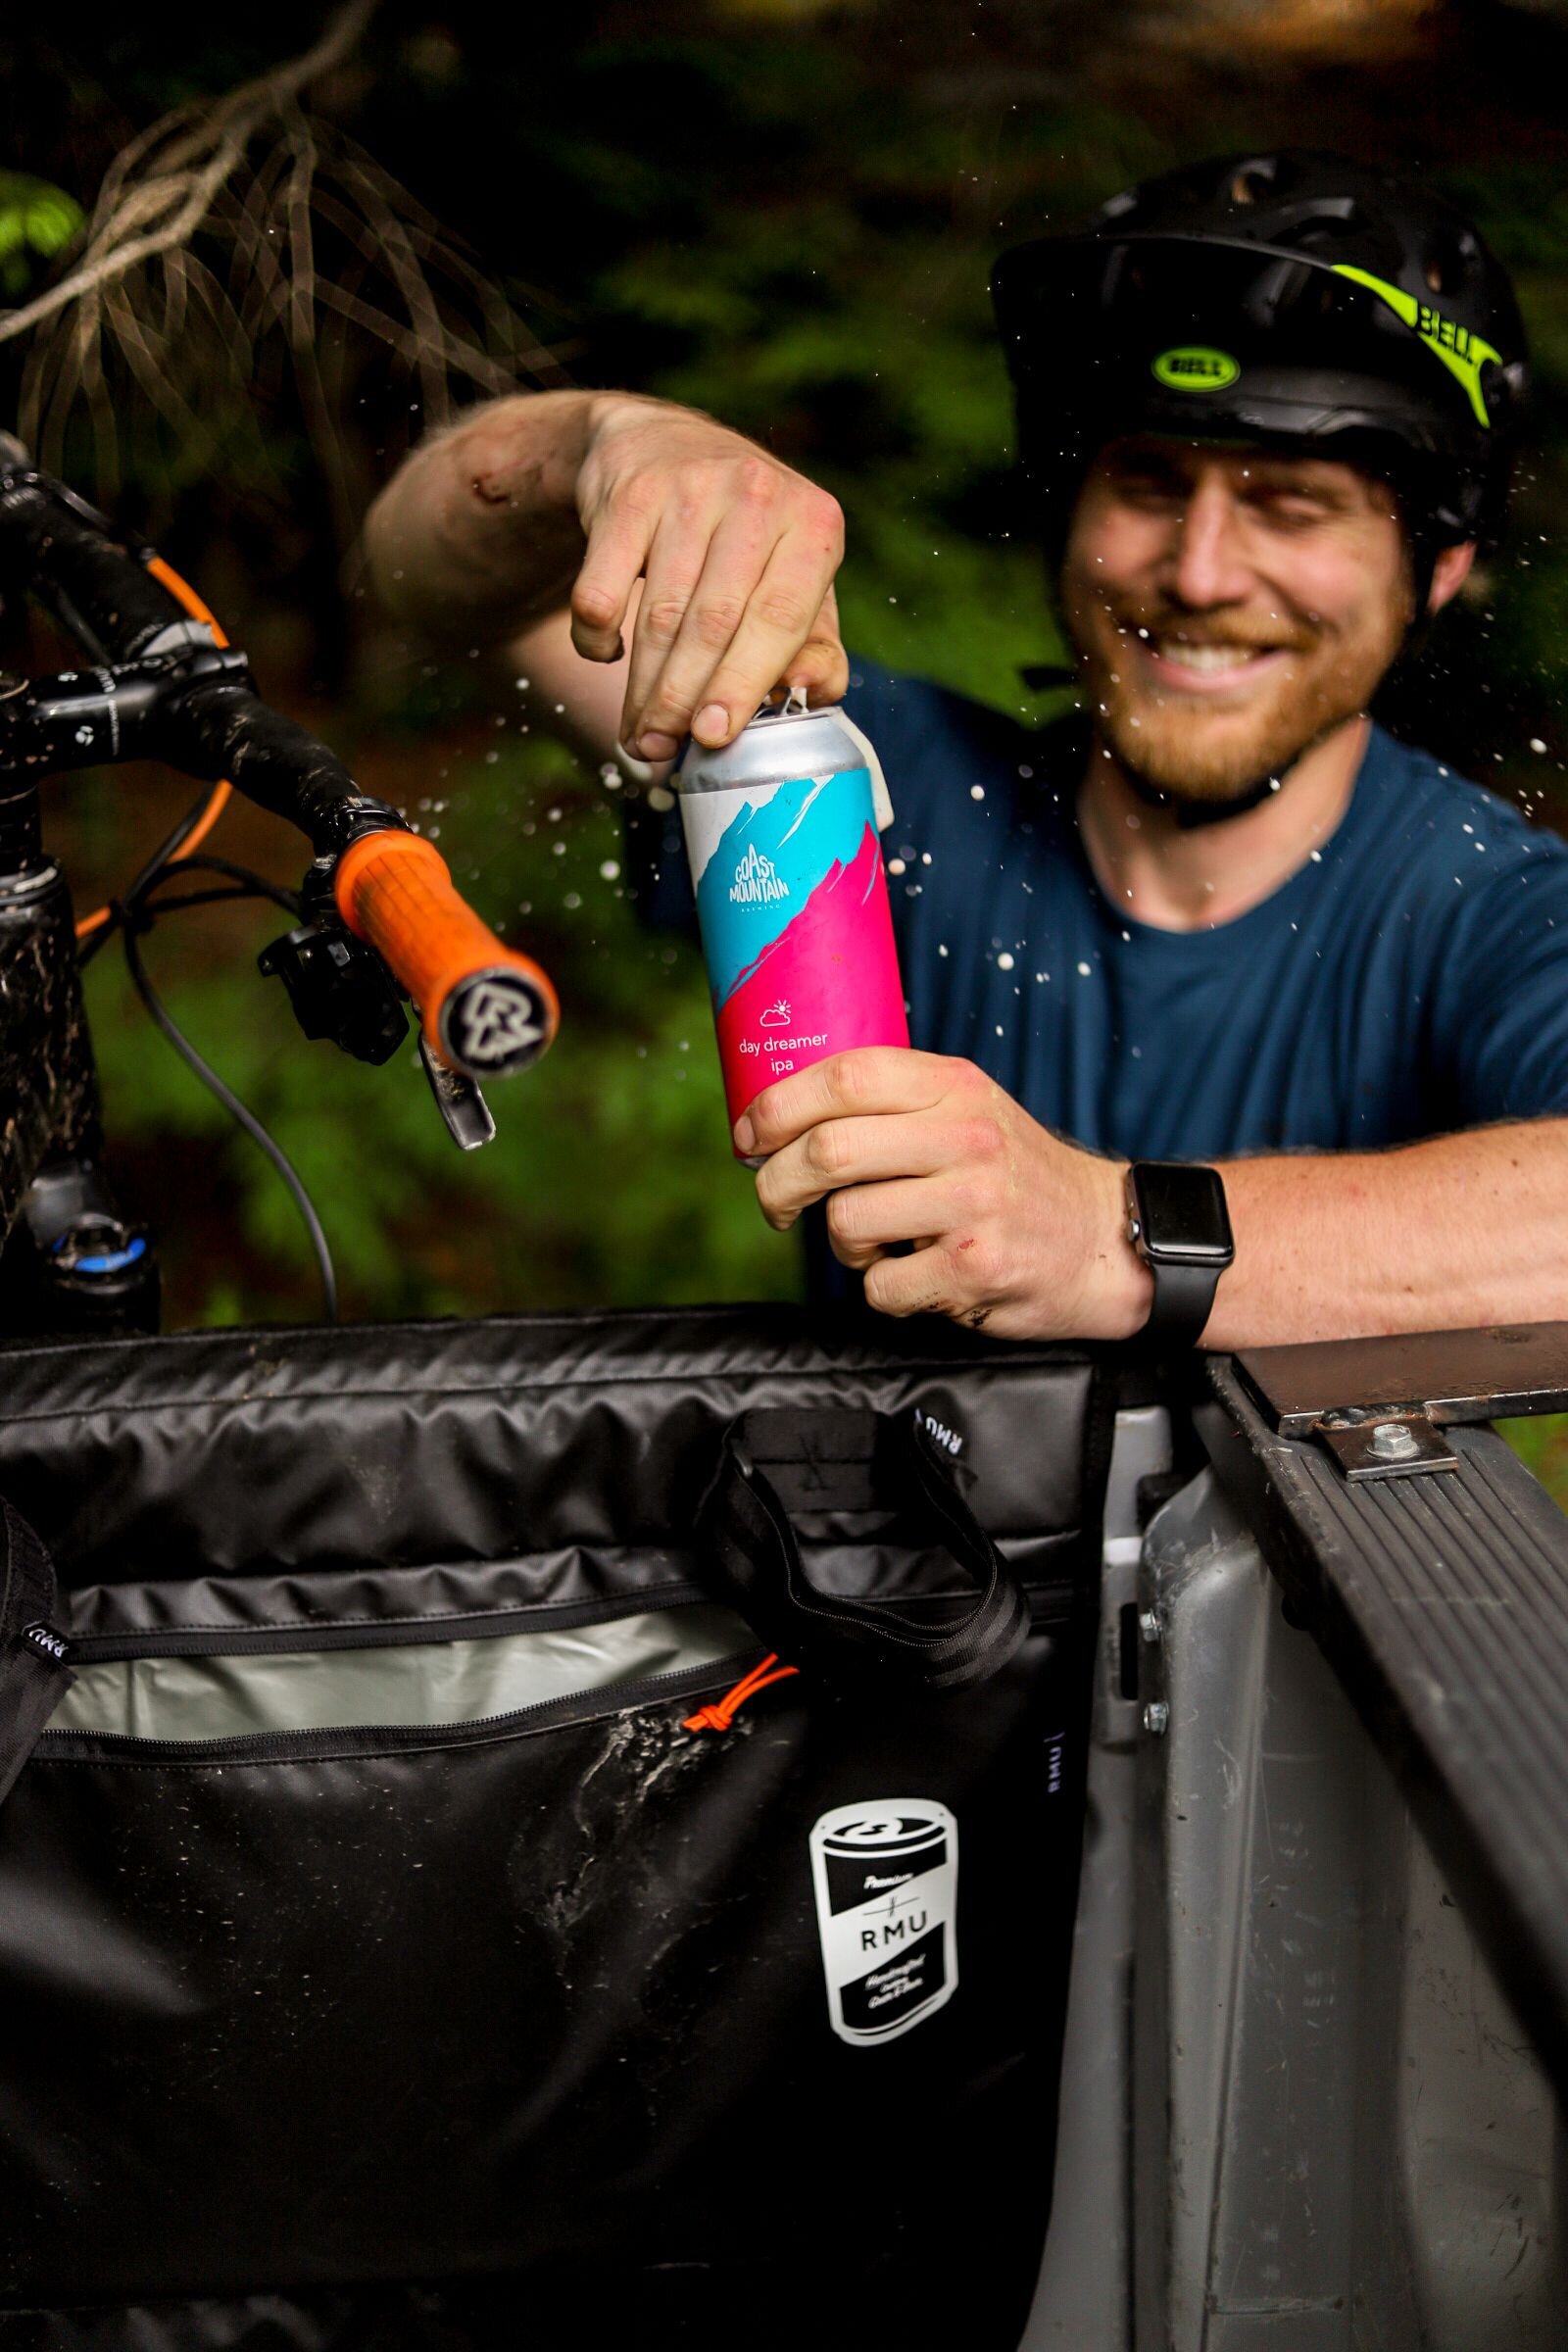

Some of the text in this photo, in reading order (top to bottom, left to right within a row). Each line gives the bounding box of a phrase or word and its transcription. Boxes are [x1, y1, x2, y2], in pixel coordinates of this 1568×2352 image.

[1417, 303, 1474, 366] BELL
[1169, 358, 1222, 377] BELL
[735, 843, 776, 883] COAST
[729, 877, 790, 903] MOUNTAIN
[739, 1034, 828, 1056] day dreamer
[770, 1058, 794, 1076] ipa
[925, 1416, 962, 1454] RMU
[28, 1629, 70, 1657] RMU
[861, 1910, 927, 1951] RMU
